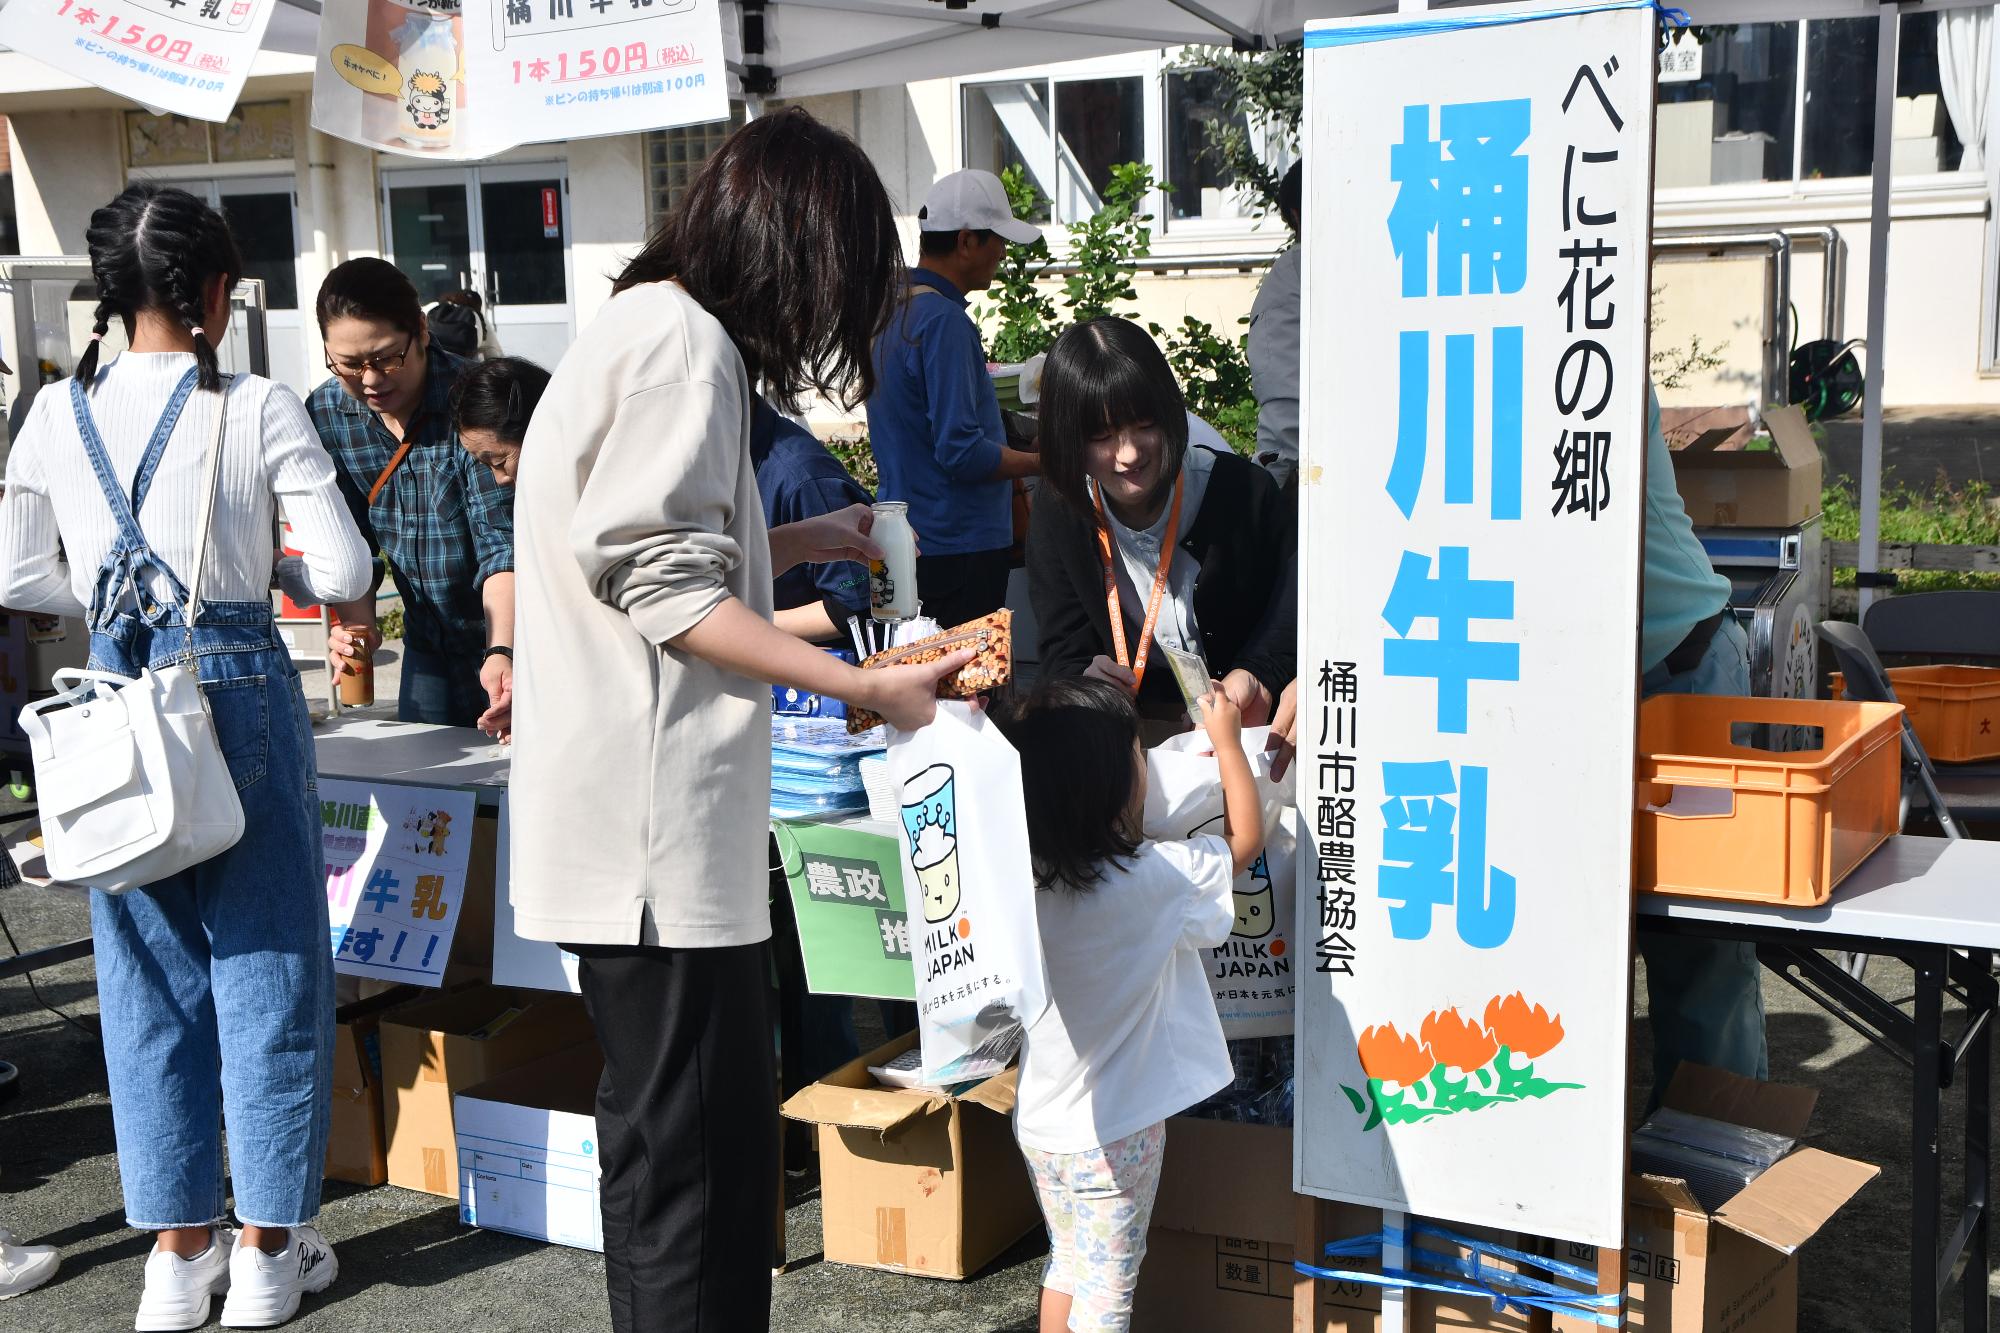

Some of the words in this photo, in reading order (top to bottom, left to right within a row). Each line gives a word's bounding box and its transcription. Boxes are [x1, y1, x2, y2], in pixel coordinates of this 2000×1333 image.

[1551, 54, 1624, 522] べに花の郷
[1378, 97, 1532, 949] 桶川牛乳
[1315, 659, 1358, 977] 桶川市酪農協会
[807, 861, 887, 901] 農政
[924, 922, 959, 957] MILK
[1213, 941, 1269, 959] MILK
[927, 942, 975, 982] JAPAN
[1215, 957, 1290, 979] JAPAN
[1225, 1261, 1262, 1285] 数量
